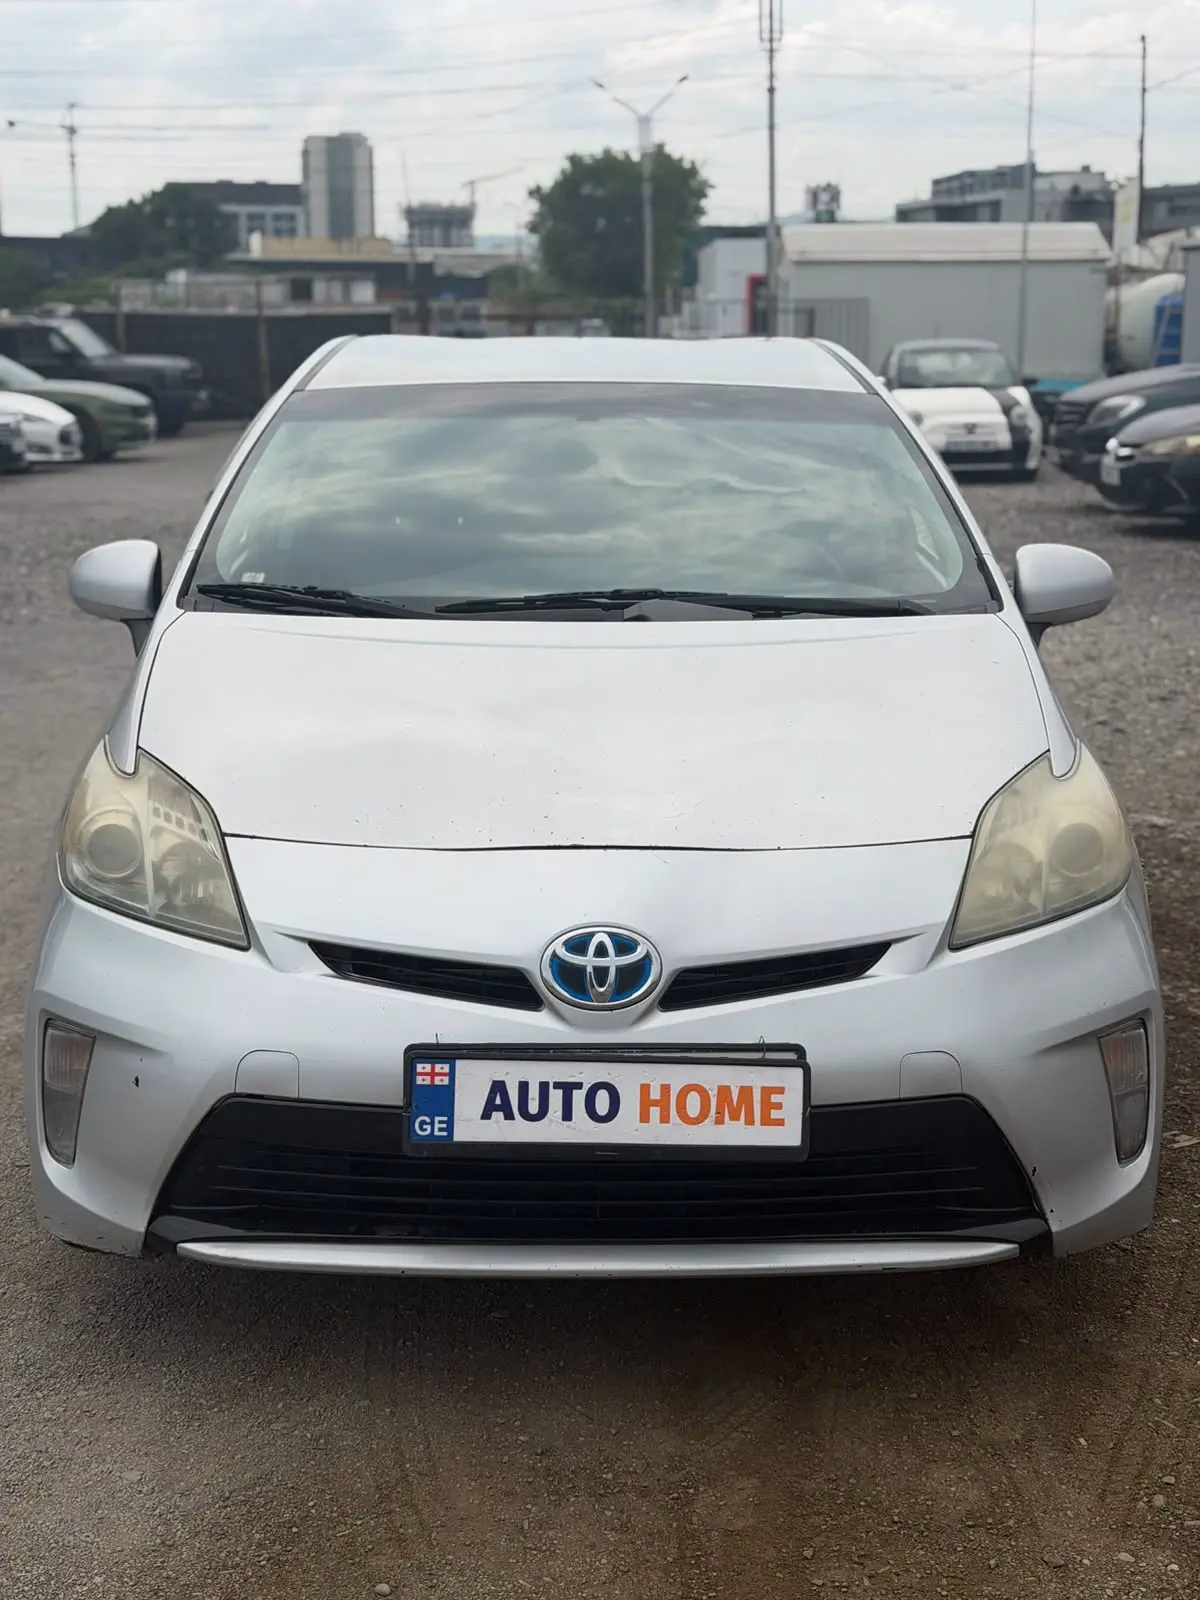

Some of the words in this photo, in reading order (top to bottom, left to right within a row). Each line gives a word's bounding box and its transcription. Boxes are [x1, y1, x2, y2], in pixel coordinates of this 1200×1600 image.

[480, 1079, 621, 1123] AUTO
[638, 1083, 786, 1127] HOME
[414, 1115, 449, 1137] GE
